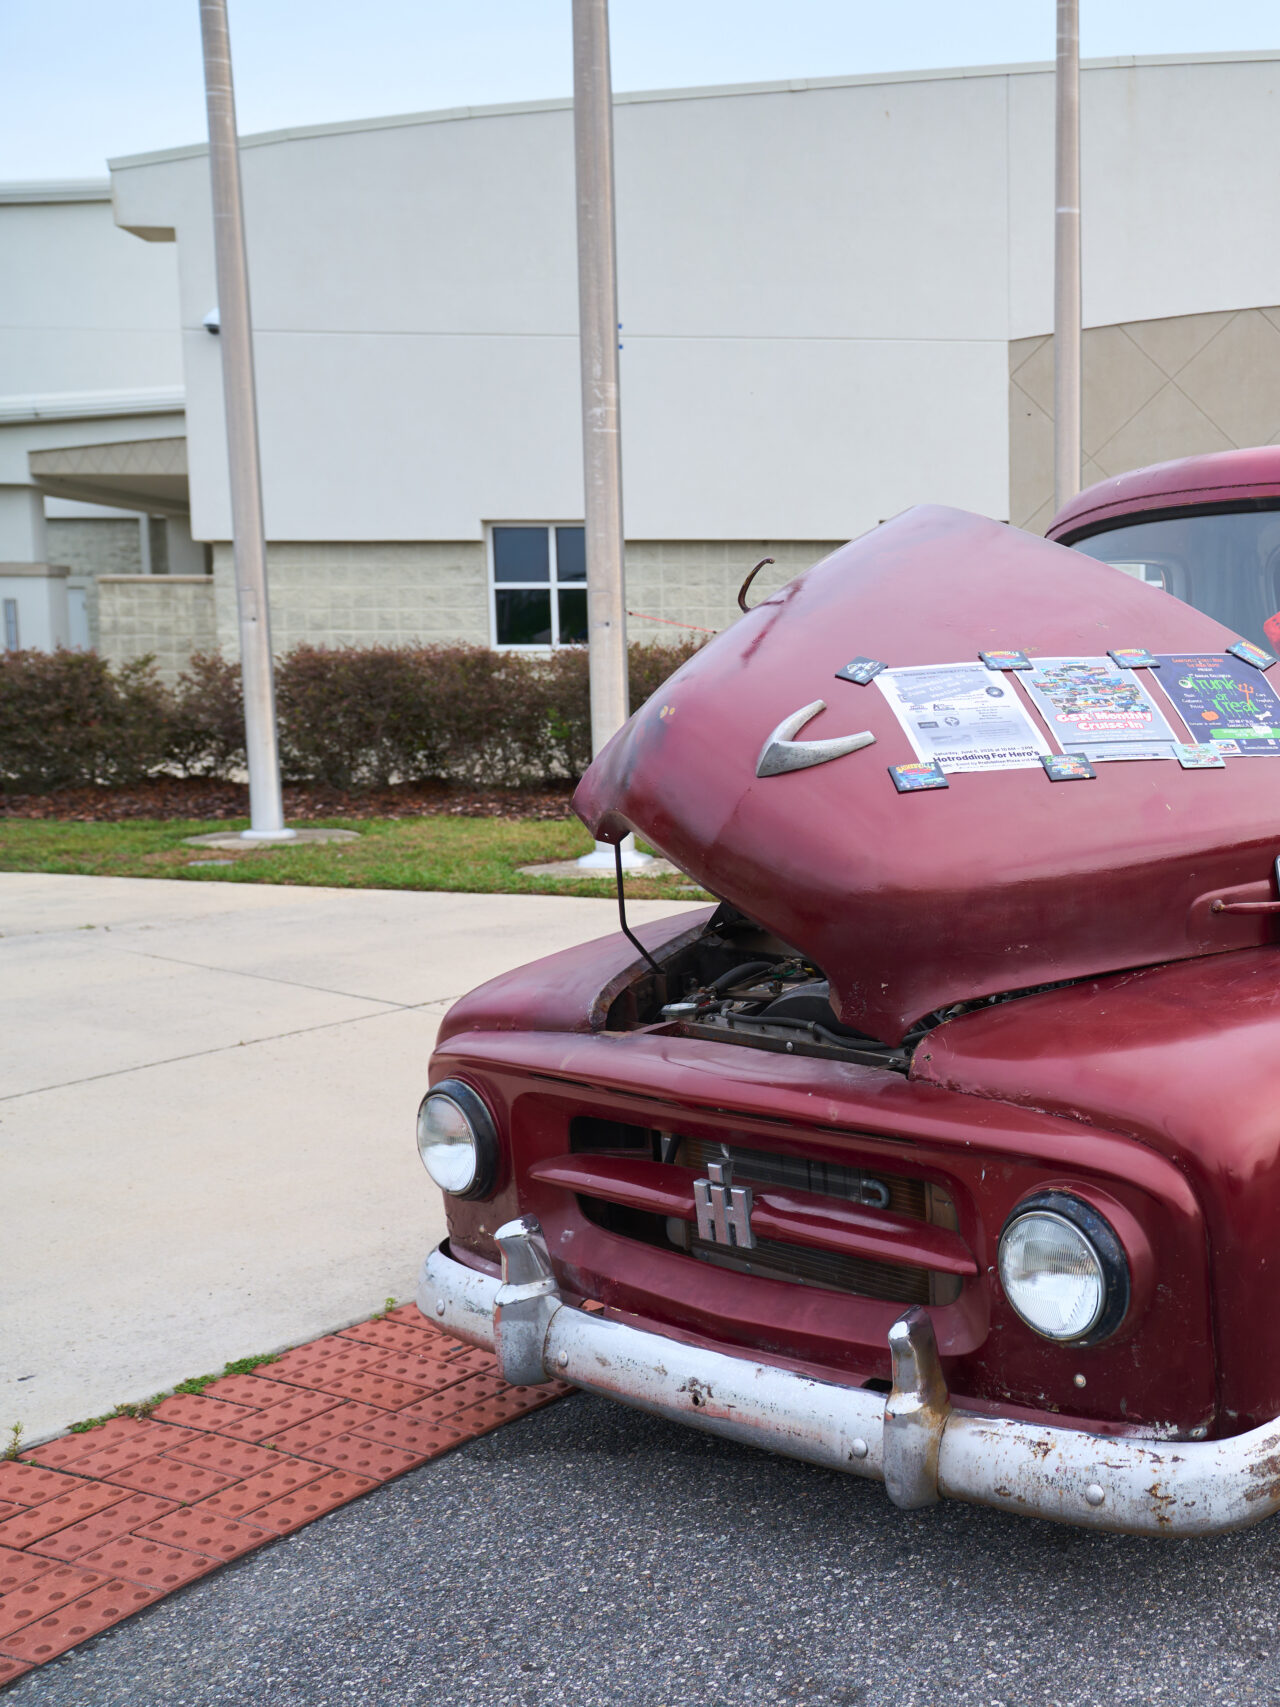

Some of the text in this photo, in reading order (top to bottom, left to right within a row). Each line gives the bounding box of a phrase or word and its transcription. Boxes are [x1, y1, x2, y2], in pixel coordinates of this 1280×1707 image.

[1183, 676, 1240, 692] Trunk
[1210, 698, 1261, 714] Treat
[1056, 711, 1153, 723] GSR Monthly
[933, 749, 1040, 764] Hotrodding For Hero's
